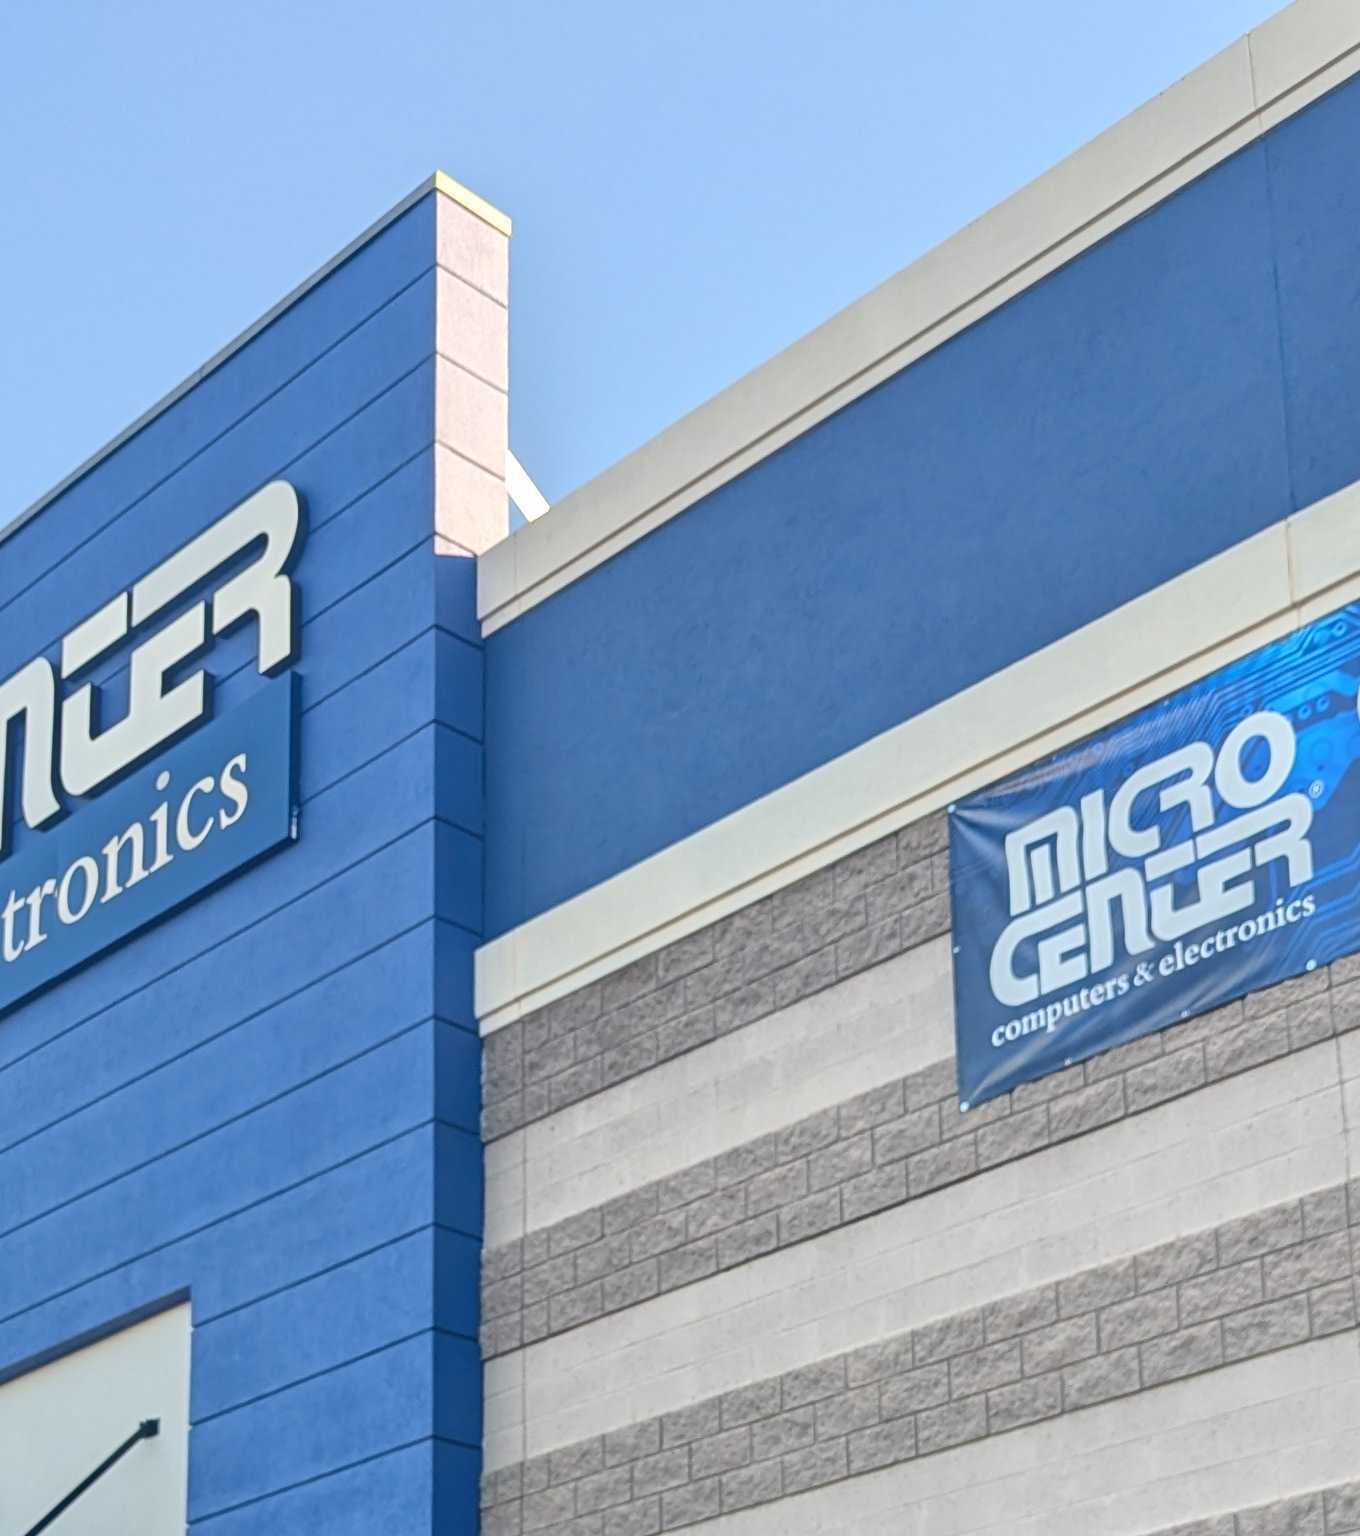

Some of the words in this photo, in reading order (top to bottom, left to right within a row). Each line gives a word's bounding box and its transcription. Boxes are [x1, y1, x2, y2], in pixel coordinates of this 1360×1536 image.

[988, 792, 1315, 1007] CENTER
[1004, 711, 1297, 917] MICRO
[991, 971, 1130, 1047] computers
[1133, 962, 1154, 987] &
[1159, 895, 1315, 977] electronics
